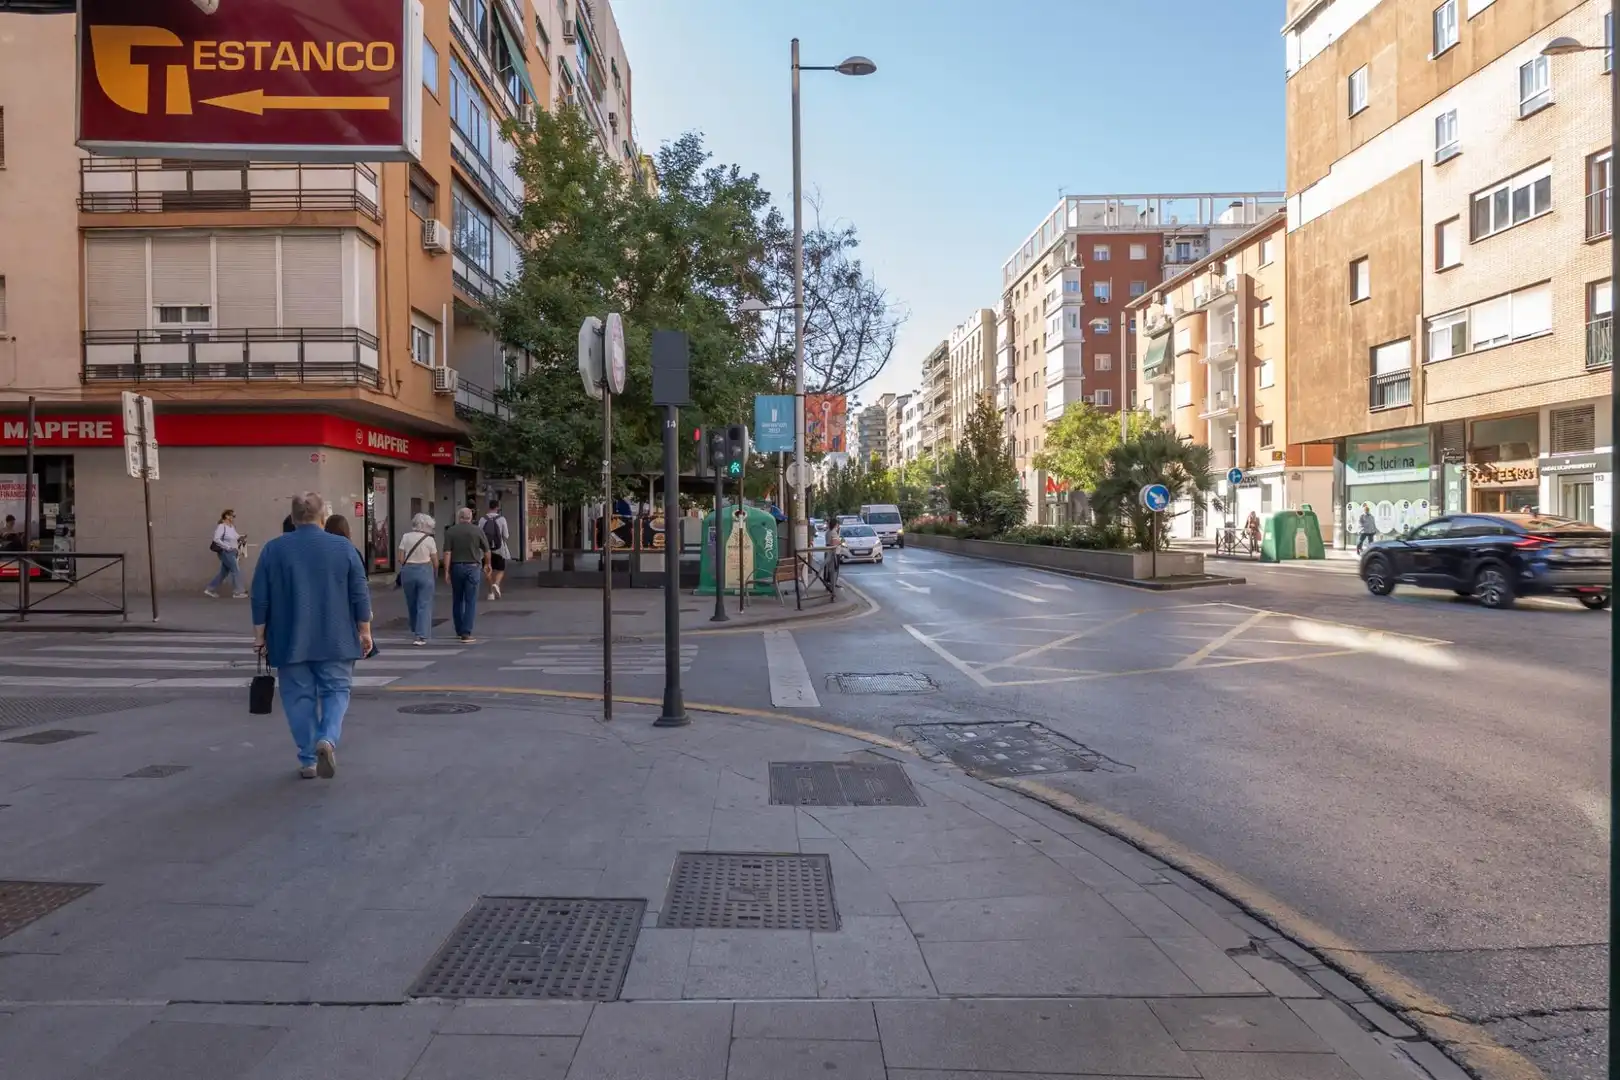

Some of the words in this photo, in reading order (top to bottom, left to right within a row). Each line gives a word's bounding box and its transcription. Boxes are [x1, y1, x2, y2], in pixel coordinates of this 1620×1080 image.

[193, 41, 395, 71] ESTANCO
[4, 421, 113, 439] MAPFRE
[368, 431, 409, 454] MAPFRE
